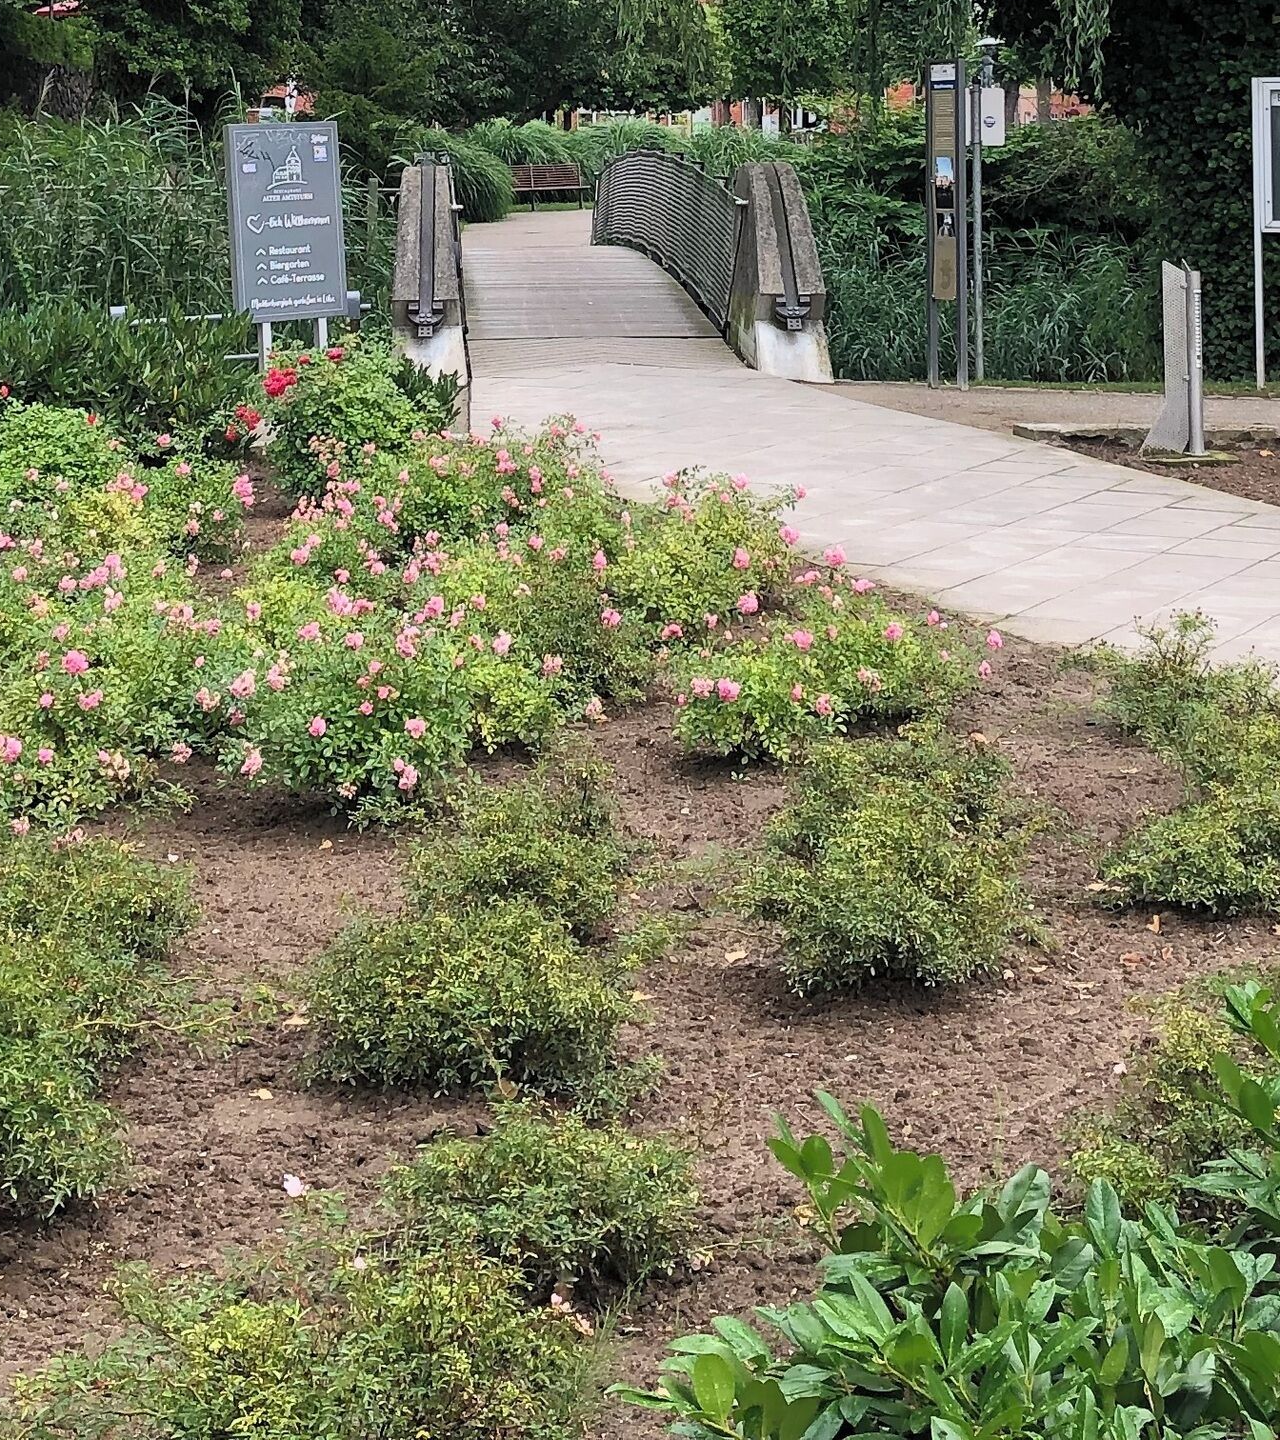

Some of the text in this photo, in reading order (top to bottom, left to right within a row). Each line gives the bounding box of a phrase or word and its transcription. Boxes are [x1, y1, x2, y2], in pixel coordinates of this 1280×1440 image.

[284, 213, 331, 229] Willkommen
[268, 243, 311, 256] Restaurant
[269, 258, 310, 271] Biergarten
[270, 273, 325, 285] Café-Terrasse
